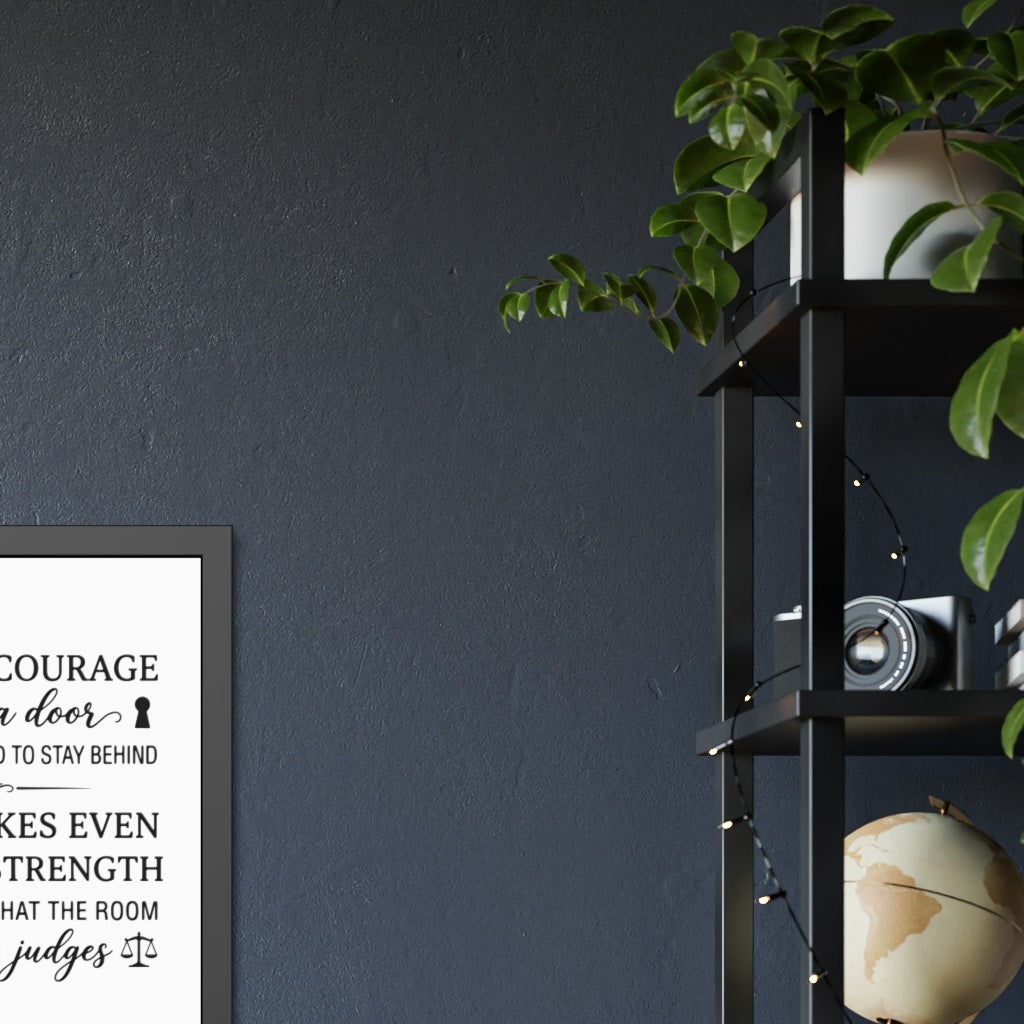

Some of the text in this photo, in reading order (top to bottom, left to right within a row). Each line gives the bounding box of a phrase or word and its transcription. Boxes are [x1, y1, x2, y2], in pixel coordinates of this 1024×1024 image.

[25, 687, 122, 729] door
[12, 745, 35, 765] TO
[41, 745, 85, 765] STAY
[91, 745, 158, 765] BEHIND
[68, 811, 160, 839] EVEN
[48, 900, 87, 921] THE
[96, 900, 159, 921] ROOM
